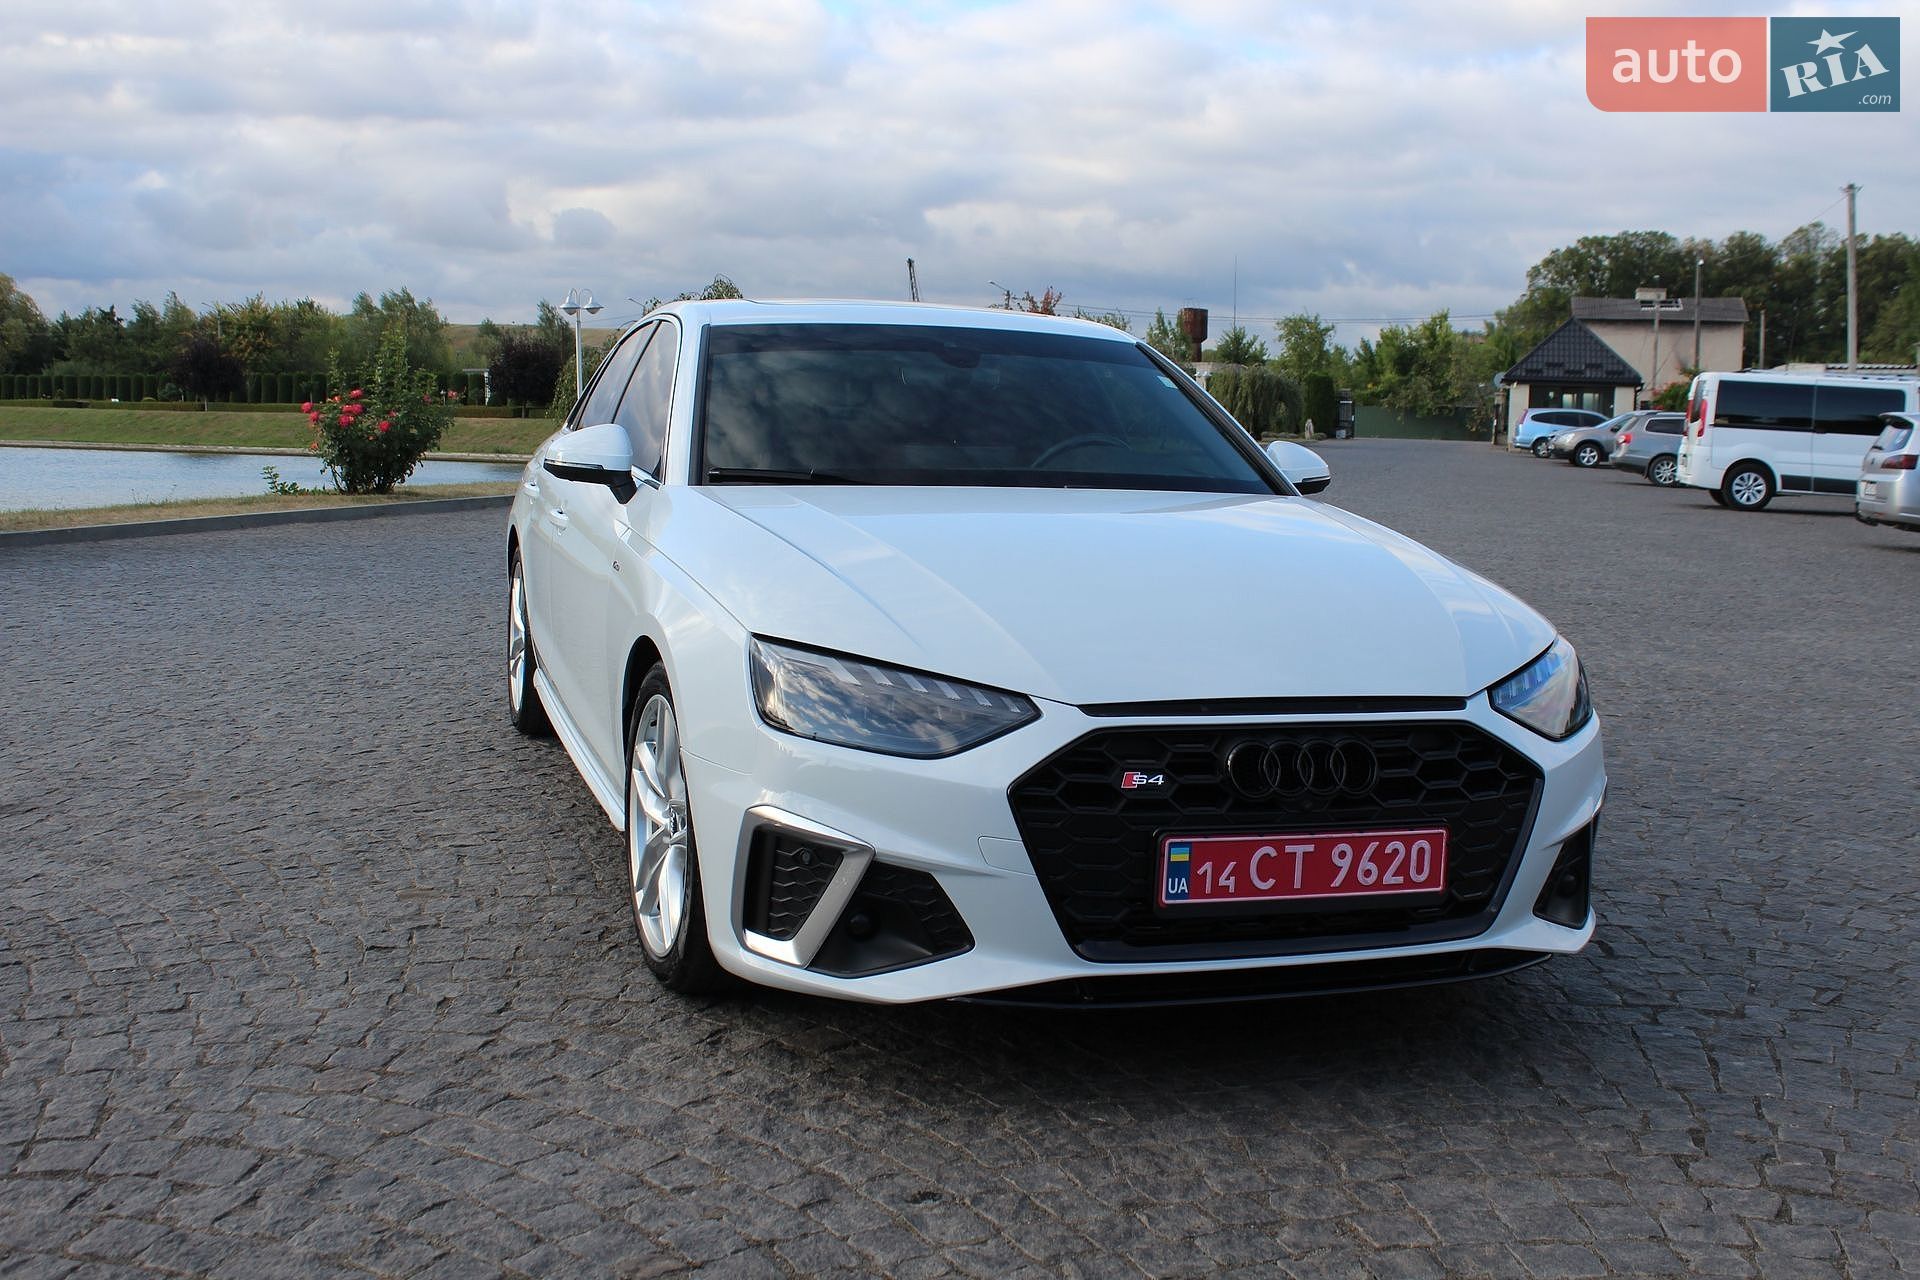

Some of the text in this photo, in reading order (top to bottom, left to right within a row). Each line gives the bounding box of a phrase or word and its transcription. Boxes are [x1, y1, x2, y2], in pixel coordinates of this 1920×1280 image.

[1131, 774, 1165, 786] S4
[1196, 839, 1431, 893] 14 CT 9620
[1168, 878, 1189, 894] UA
